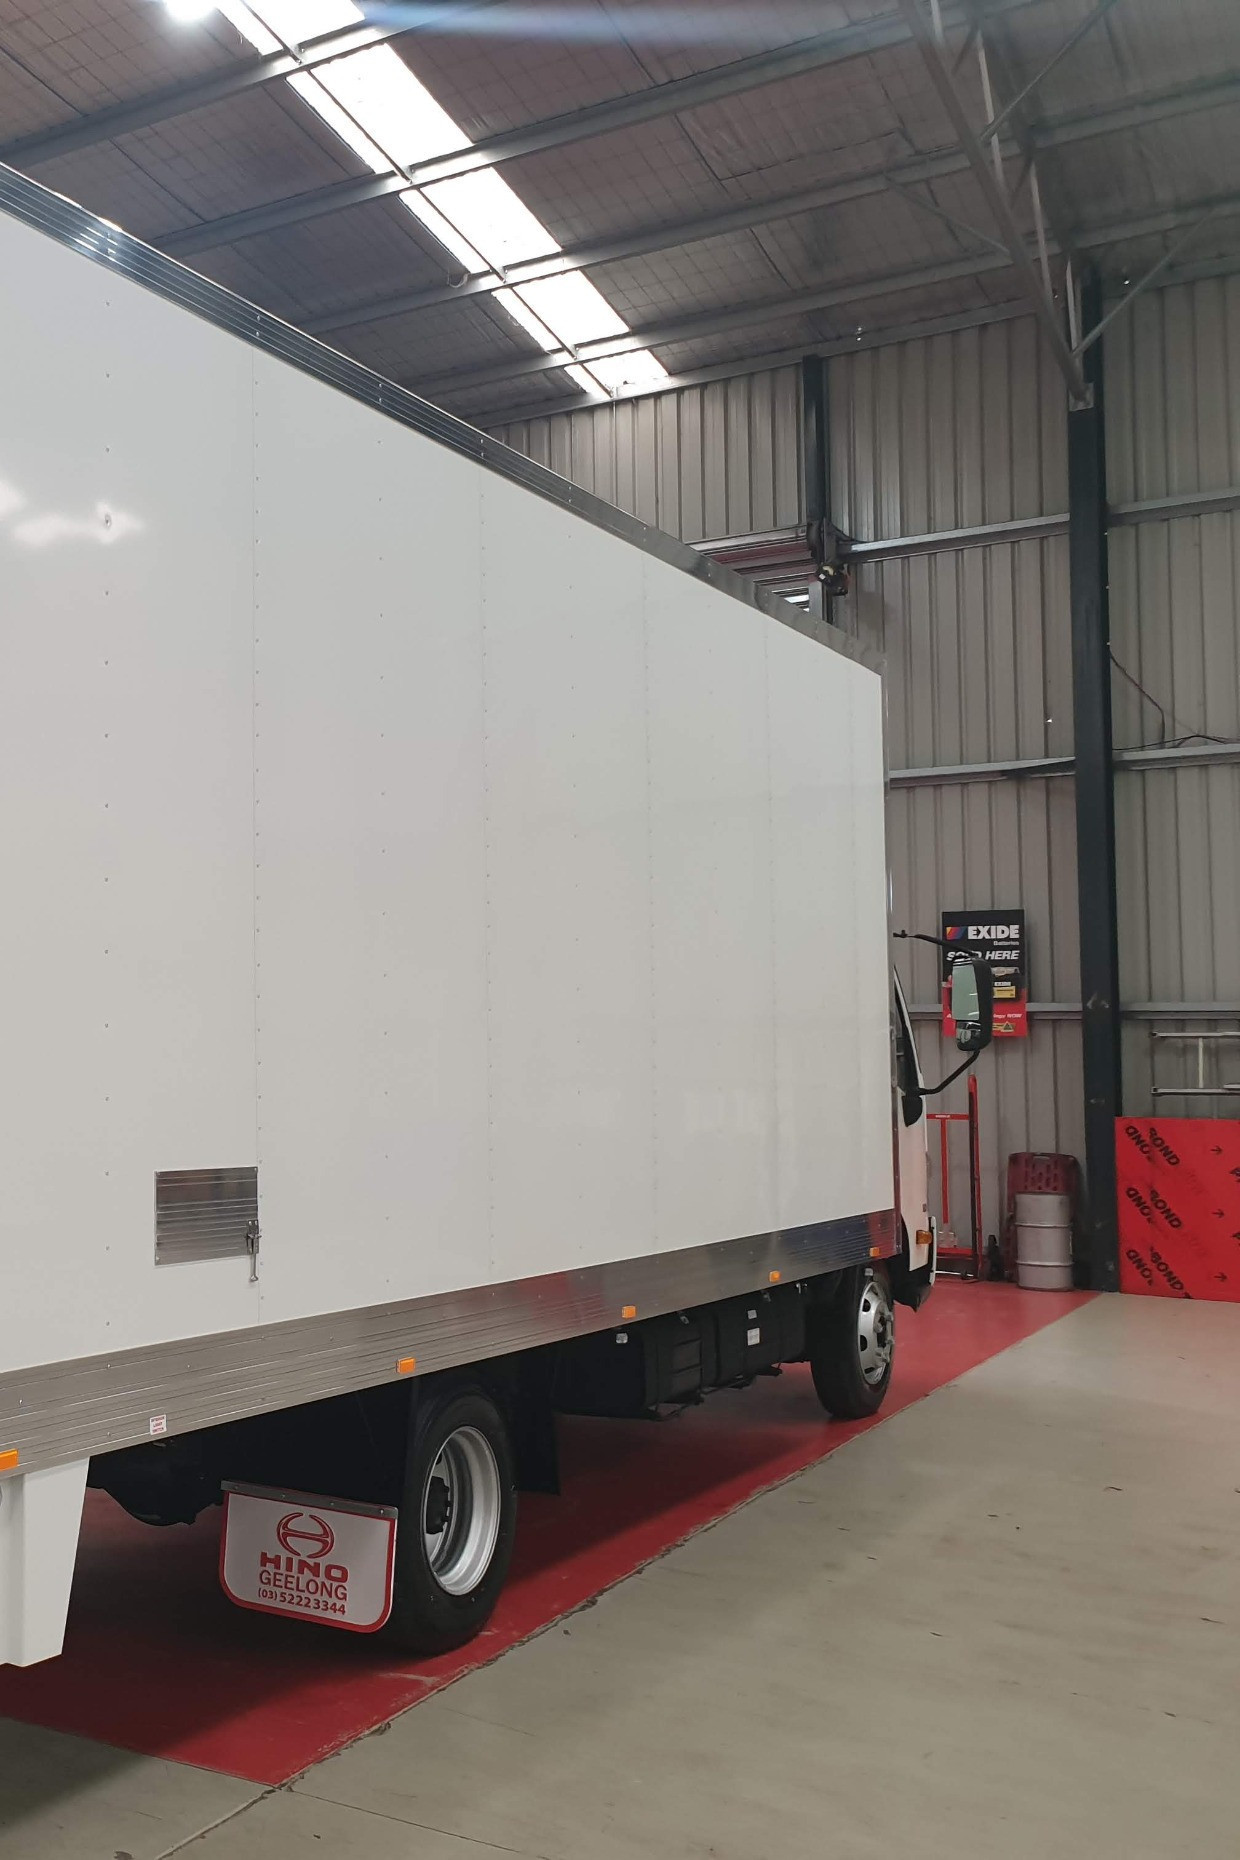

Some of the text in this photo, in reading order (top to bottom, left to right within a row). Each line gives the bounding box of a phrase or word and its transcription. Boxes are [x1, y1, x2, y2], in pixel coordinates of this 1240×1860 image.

[968, 925, 1020, 940] EXIDE
[985, 950, 1020, 960] HERE
[260, 1551, 349, 1583] HINO
[260, 1569, 348, 1602] GEELONG
[258, 1588, 346, 1615] (03) 52223344
